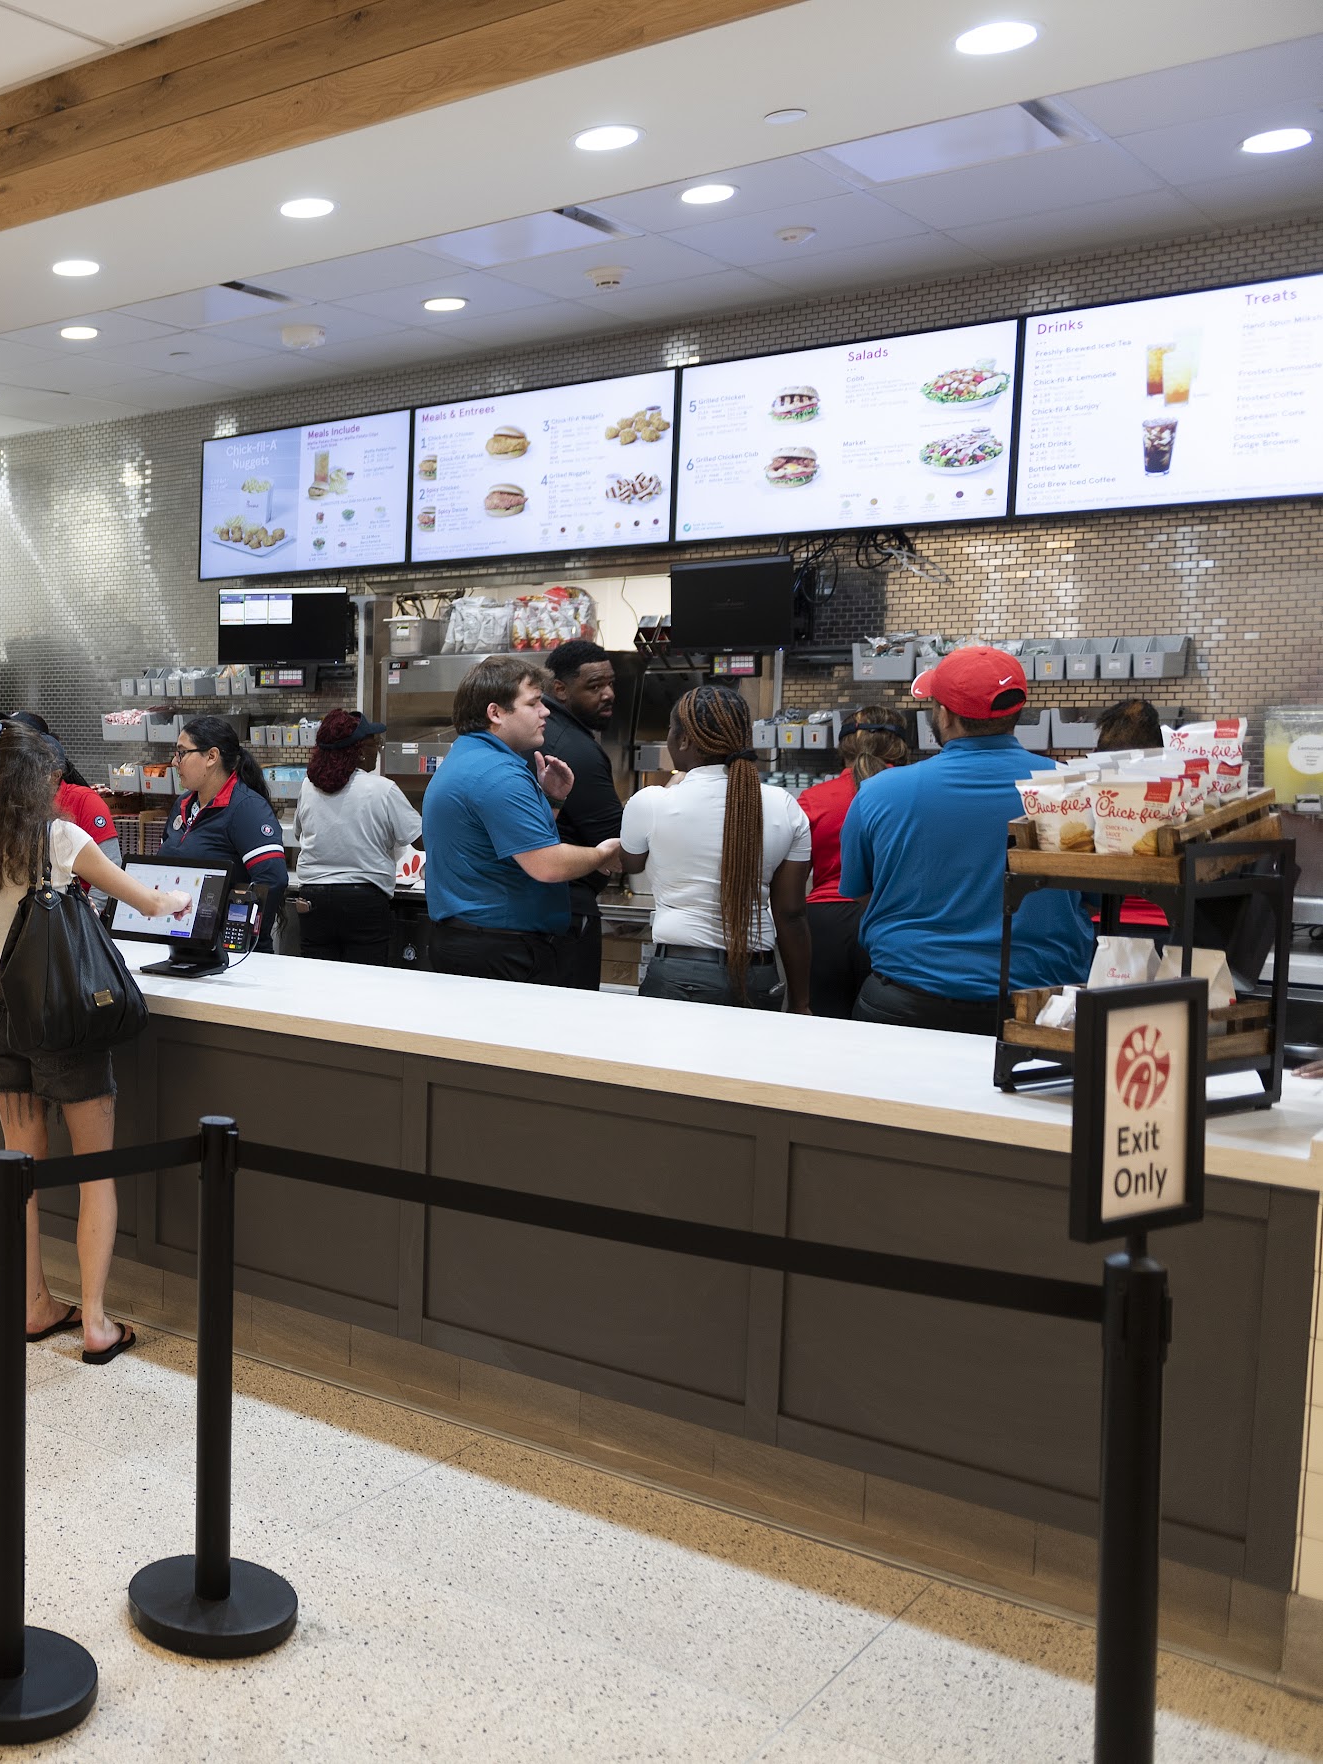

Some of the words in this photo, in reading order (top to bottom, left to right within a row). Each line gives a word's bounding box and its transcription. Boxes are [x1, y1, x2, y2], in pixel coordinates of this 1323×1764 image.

[1245, 290, 1297, 306] Treats
[1037, 320, 1084, 336] Drinks
[1098, 342, 1116, 350] Iced
[1118, 338, 1132, 346] Tea
[848, 347, 889, 363] Salads
[1275, 362, 1323, 374] Lemonade
[846, 375, 865, 383] Cobb
[1076, 371, 1117, 382] Lemonade
[1273, 390, 1305, 400] Coffee
[689, 400, 697, 413] 5
[698, 396, 719, 405] Grilled
[720, 394, 746, 403] Chicken
[422, 412, 447, 424] Meals
[450, 409, 457, 419] &
[459, 404, 496, 418] Entrees
[1281, 409, 1306, 417] Cone
[308, 428, 330, 440] Meals
[332, 424, 361, 437] Include
[542, 420, 550, 432] 3
[1233, 431, 1281, 441] Chocolate
[420, 438, 427, 449] 1
[842, 440, 867, 448] Market
[1048, 440, 1072, 448] Drinks
[1233, 441, 1260, 450] Fudge
[1262, 438, 1300, 448] Brownie
[232, 456, 270, 471] Nuggets
[686, 458, 694, 472] 6
[696, 456, 716, 464] Grilled
[718, 453, 743, 462] Chicken
[744, 450, 759, 459] Club
[1028, 464, 1056, 473] Bottled
[1058, 462, 1081, 470] Water
[540, 474, 548, 486] 4
[1027, 482, 1046, 490] Cold
[418, 488, 426, 500] 2
[438, 508, 452, 516] Spicy
[1118, 1121, 1161, 1158] Exit
[1114, 1161, 1168, 1200] Only
